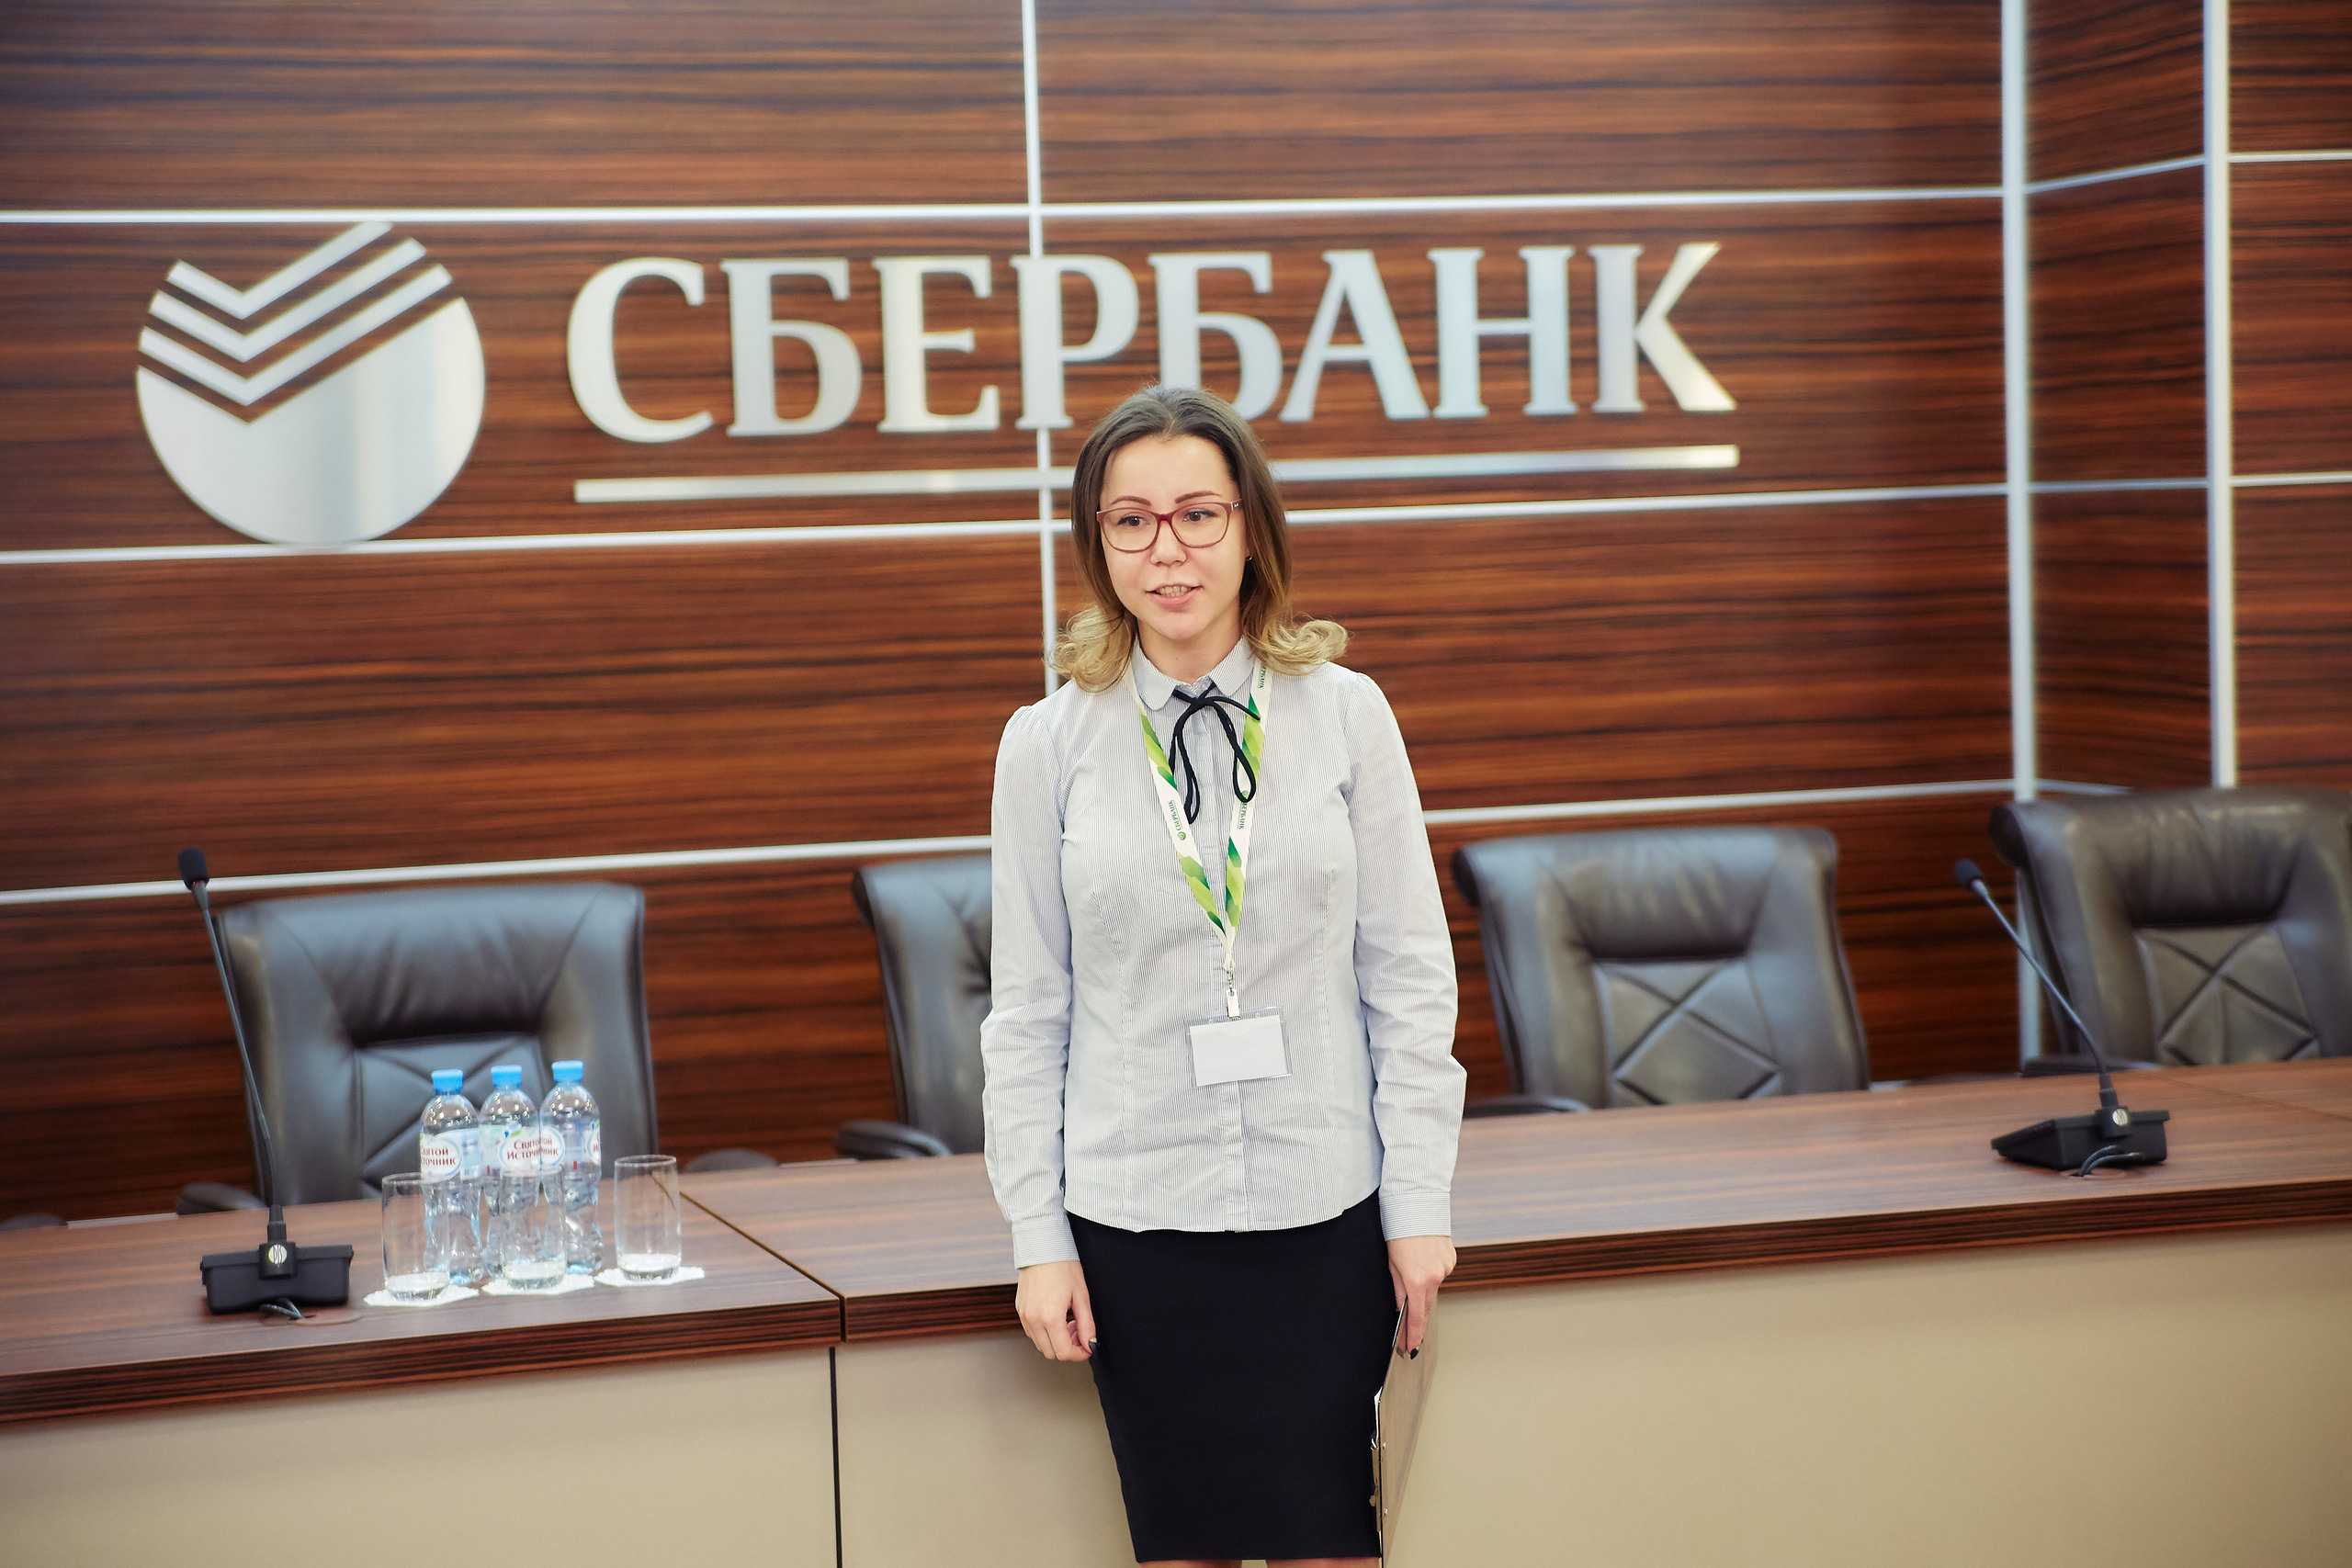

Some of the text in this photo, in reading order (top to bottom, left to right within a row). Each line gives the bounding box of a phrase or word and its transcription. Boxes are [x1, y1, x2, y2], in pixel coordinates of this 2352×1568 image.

[565, 240, 1738, 445] СБЕРБАНК
[1168, 799, 1182, 831] СБЕРБАНК
[1238, 802, 1248, 830] БЕРБАНК
